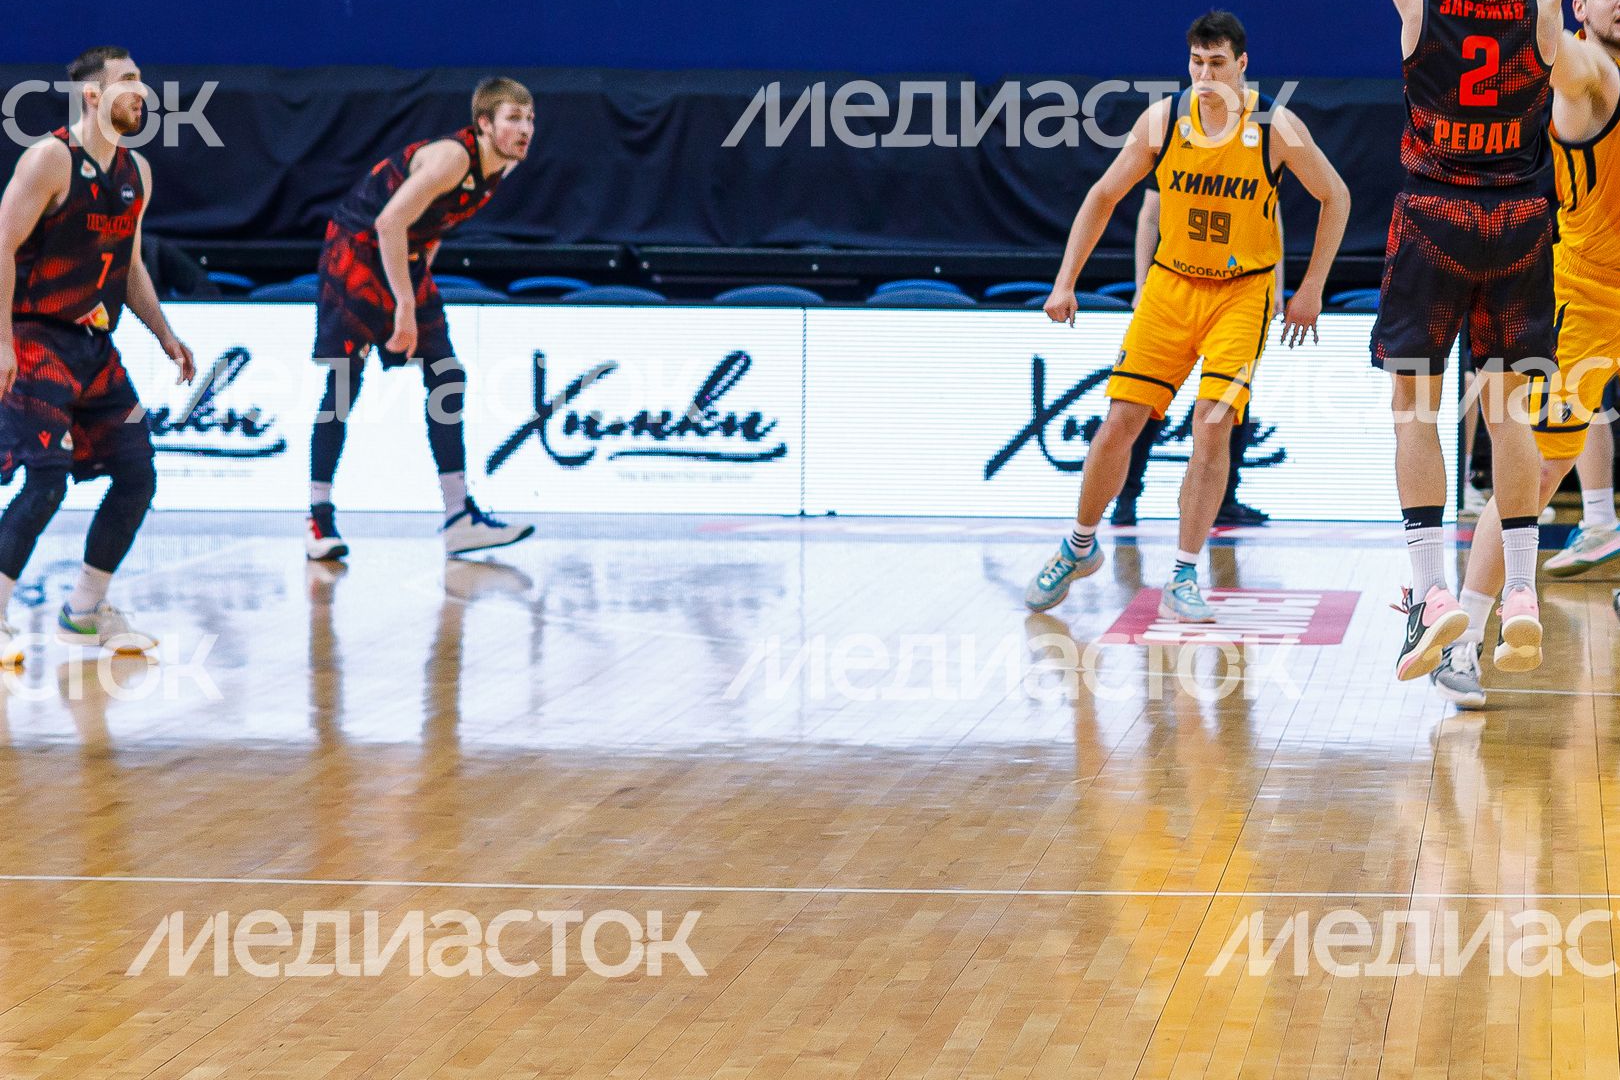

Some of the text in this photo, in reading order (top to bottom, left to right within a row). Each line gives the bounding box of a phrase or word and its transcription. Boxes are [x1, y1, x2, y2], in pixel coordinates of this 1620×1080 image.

[1459, 35, 1500, 107] 2
[1433, 119, 1521, 154] РЕВДА
[1169, 170, 1259, 200] ХИМКИ
[1188, 208, 1232, 245] 99
[97, 252, 114, 290] 7
[485, 350, 780, 475] Химки
